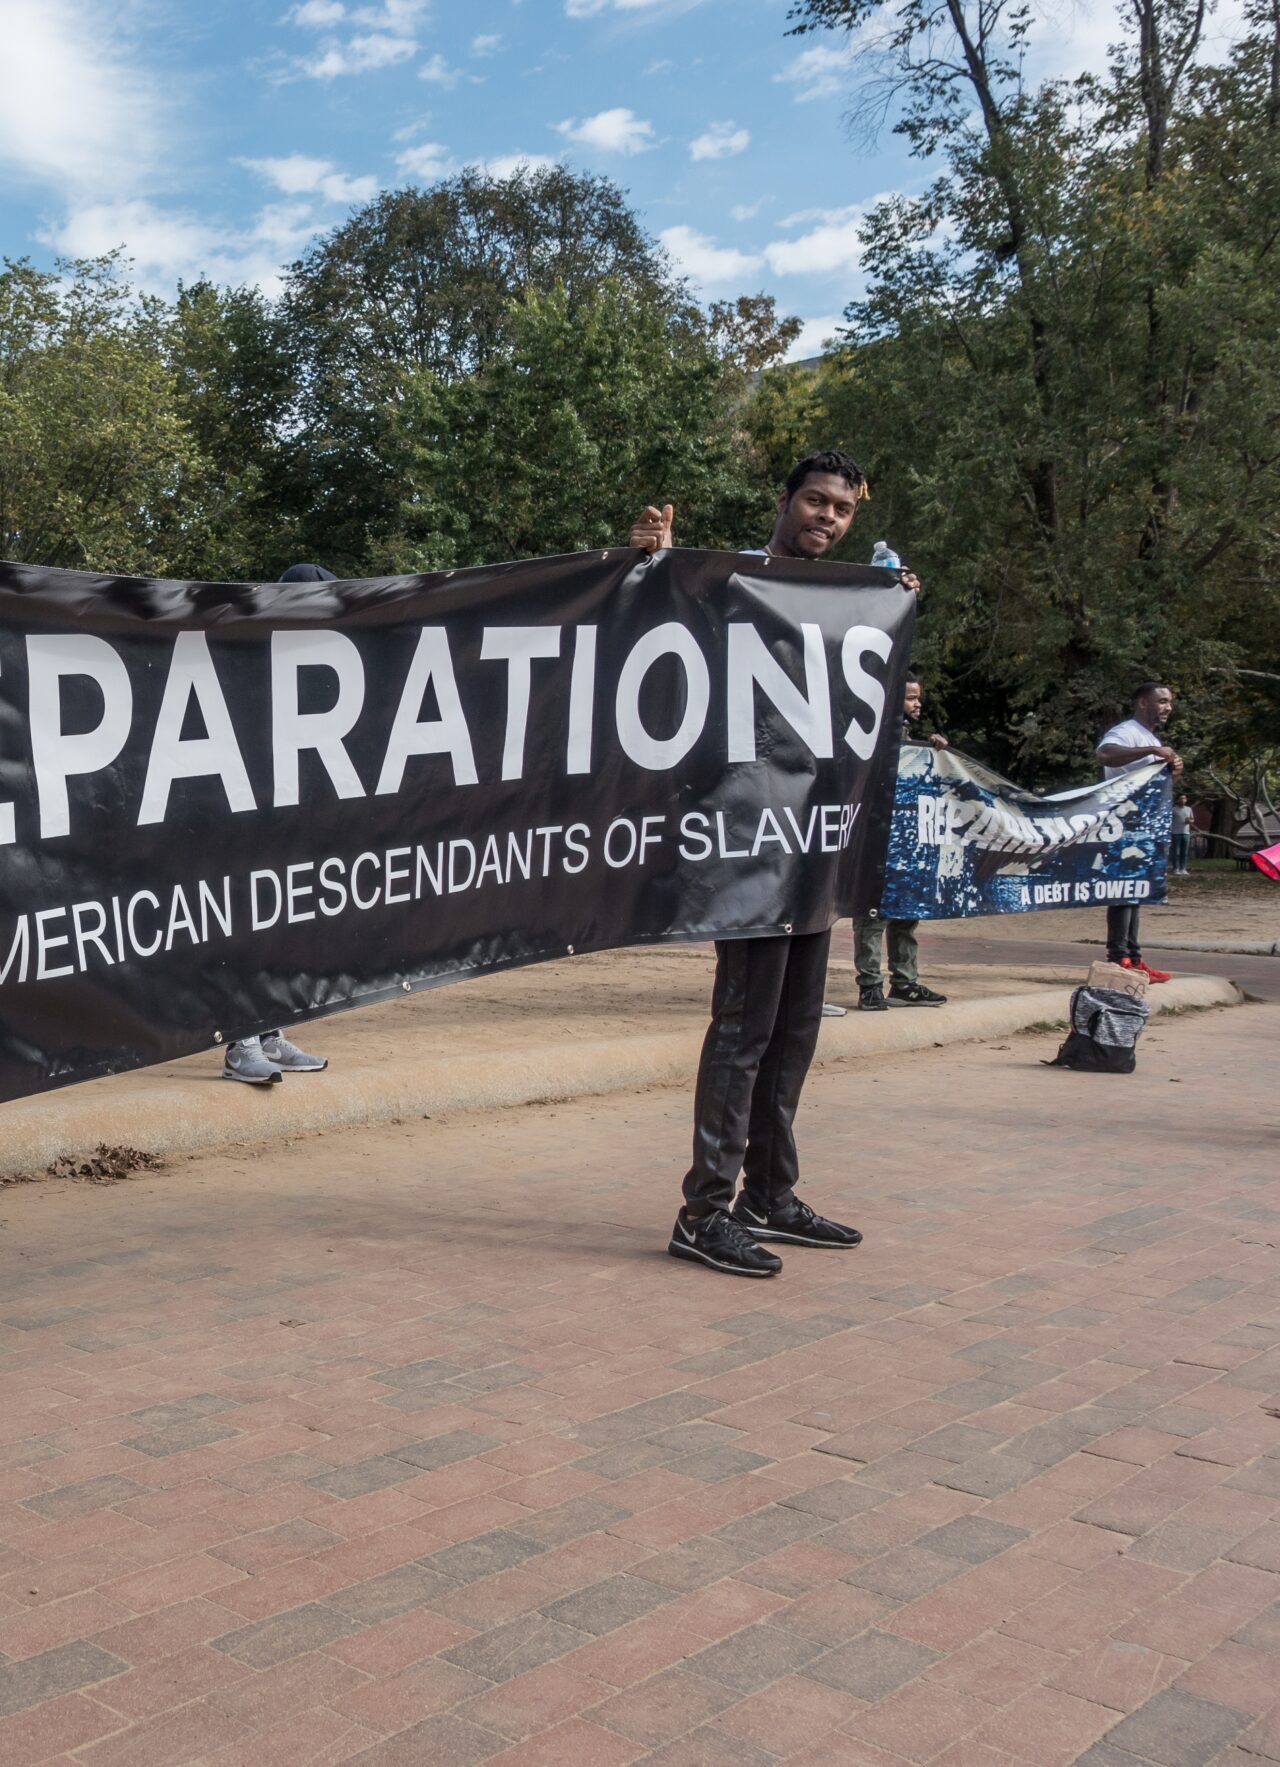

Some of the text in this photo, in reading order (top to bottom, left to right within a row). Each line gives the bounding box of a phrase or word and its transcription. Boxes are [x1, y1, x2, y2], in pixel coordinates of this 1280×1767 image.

[250, 823, 591, 931] DESCENDANTS
[603, 816, 666, 869] OF
[678, 803, 862, 861] SLAVERY
[1020, 880, 1151, 906] A DEBT IS OWED
